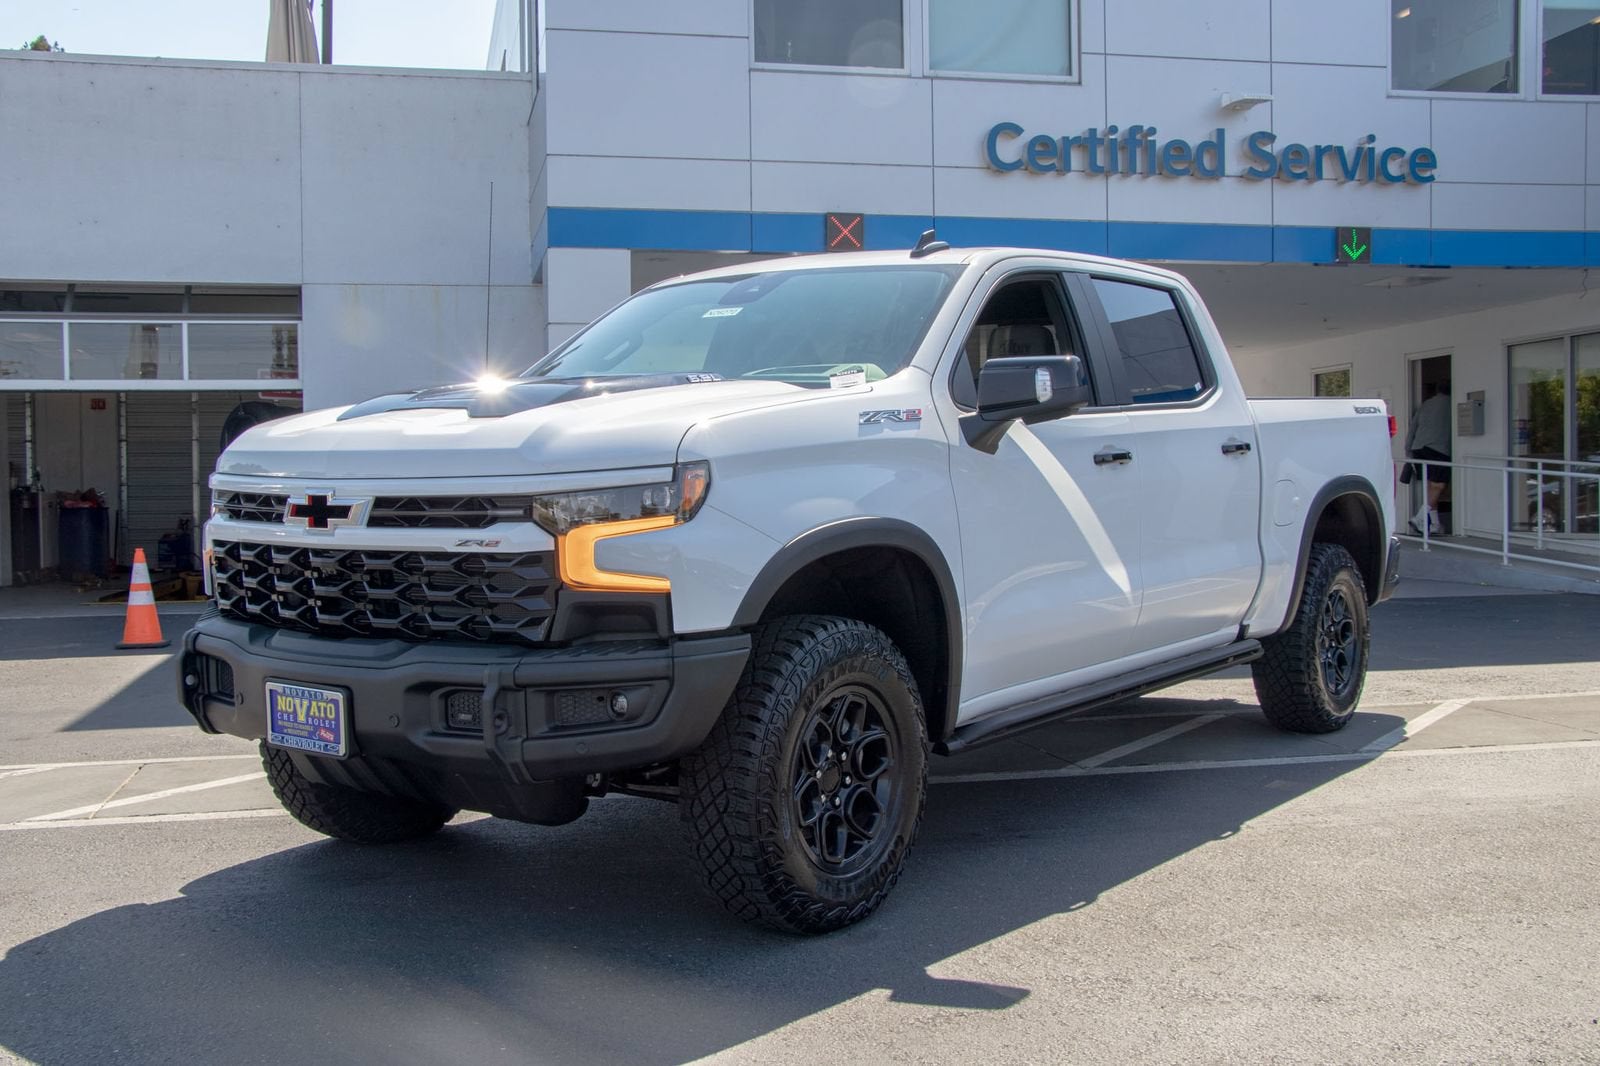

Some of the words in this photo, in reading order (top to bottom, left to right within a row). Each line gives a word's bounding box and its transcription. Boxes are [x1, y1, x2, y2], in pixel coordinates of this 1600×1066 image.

[986, 121, 1226, 178] Certified
[1245, 130, 1438, 184] Service
[858, 409, 922, 425] ZR2
[455, 539, 502, 547] ZR2
[277, 696, 336, 723] NOVATO
[284, 736, 324, 751] CHEVROLET
